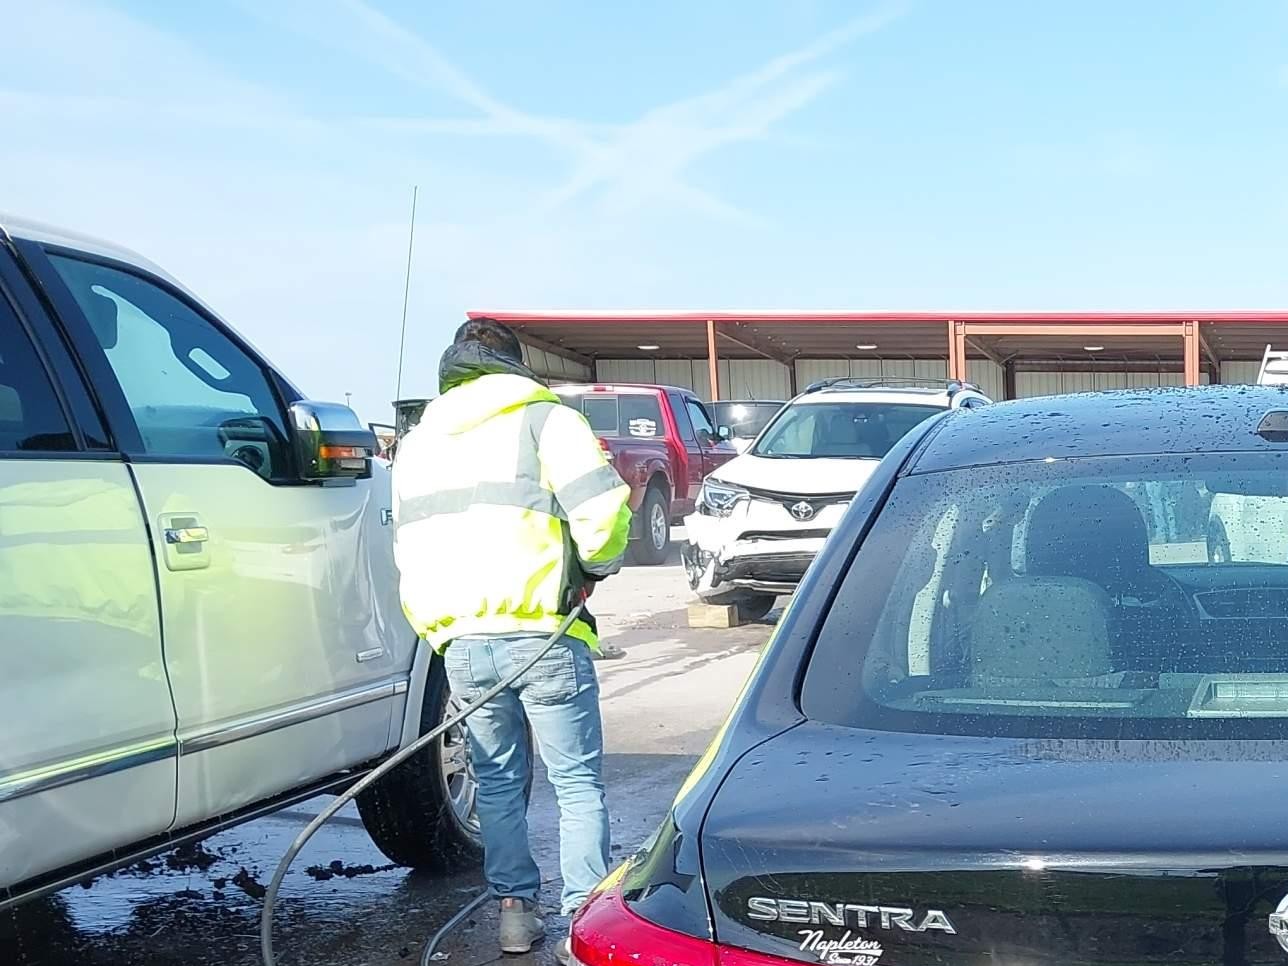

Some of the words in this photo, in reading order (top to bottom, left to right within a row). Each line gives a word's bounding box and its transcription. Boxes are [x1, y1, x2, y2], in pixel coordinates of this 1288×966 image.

[747, 897, 957, 935] SENTRA
[797, 929, 883, 959] Napleton
[851, 954, 880, 966] 1931
